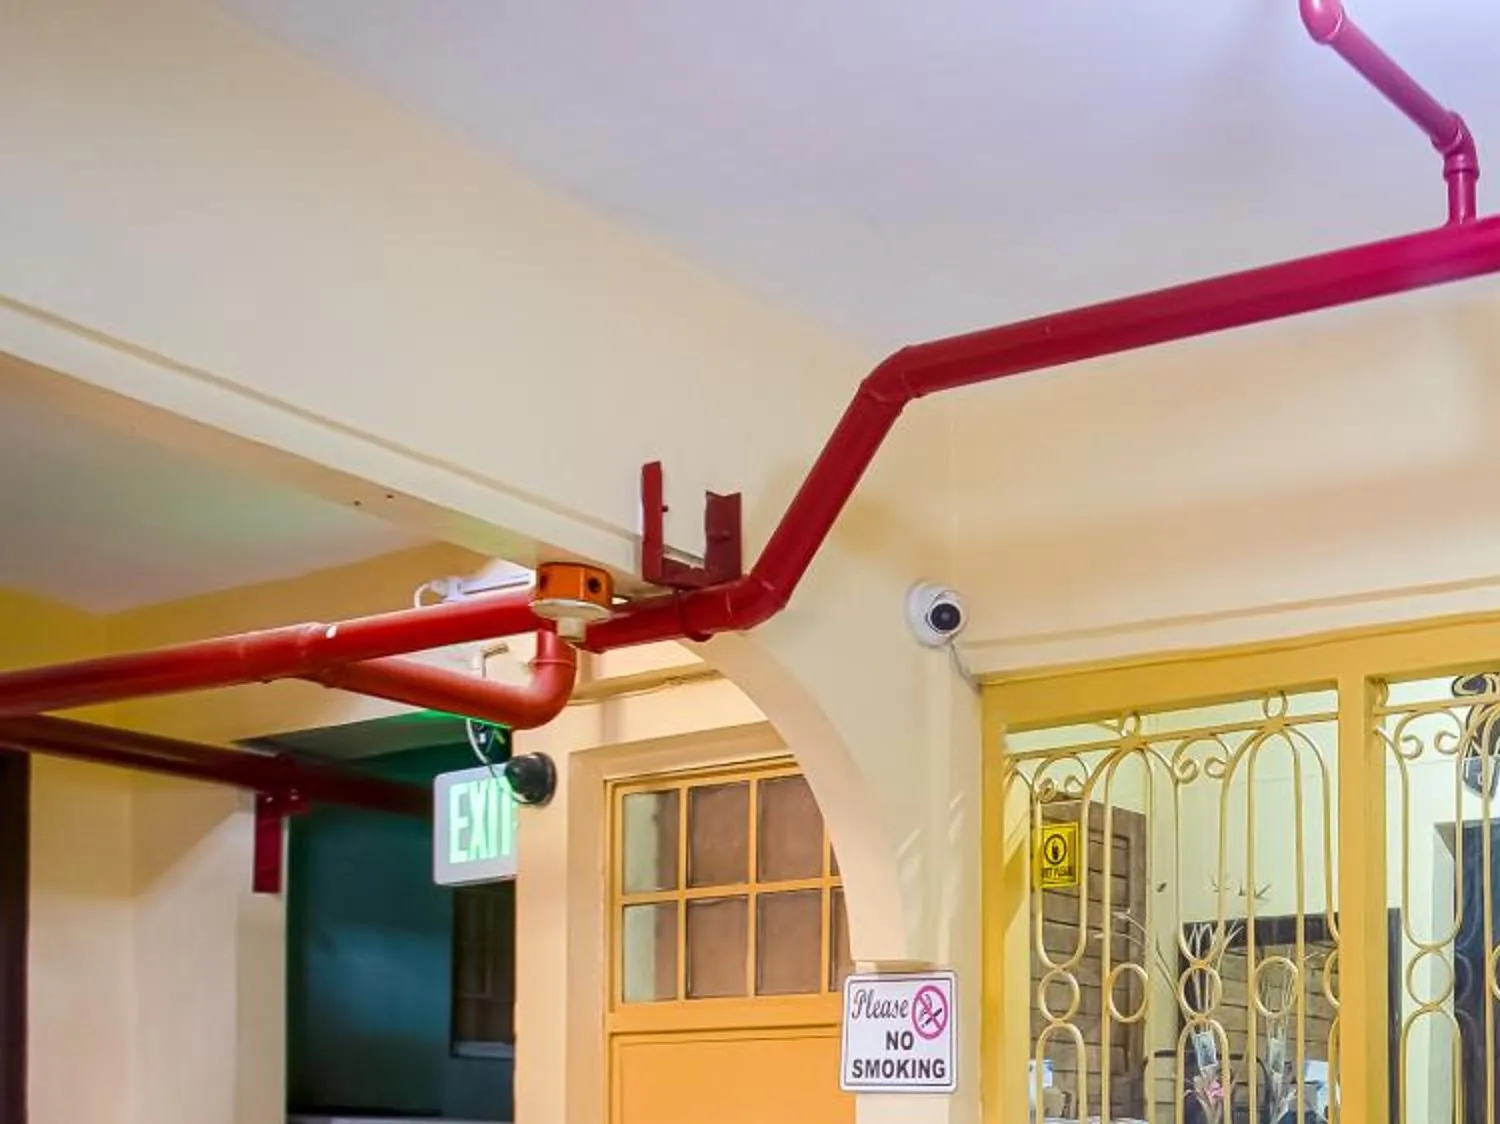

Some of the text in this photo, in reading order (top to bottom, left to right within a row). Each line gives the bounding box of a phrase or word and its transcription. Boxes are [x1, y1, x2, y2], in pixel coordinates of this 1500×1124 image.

[450, 776, 512, 863] EXIT
[852, 988, 909, 1020] Please
[885, 1030, 914, 1051] NO
[852, 1058, 945, 1079] SMOKING
